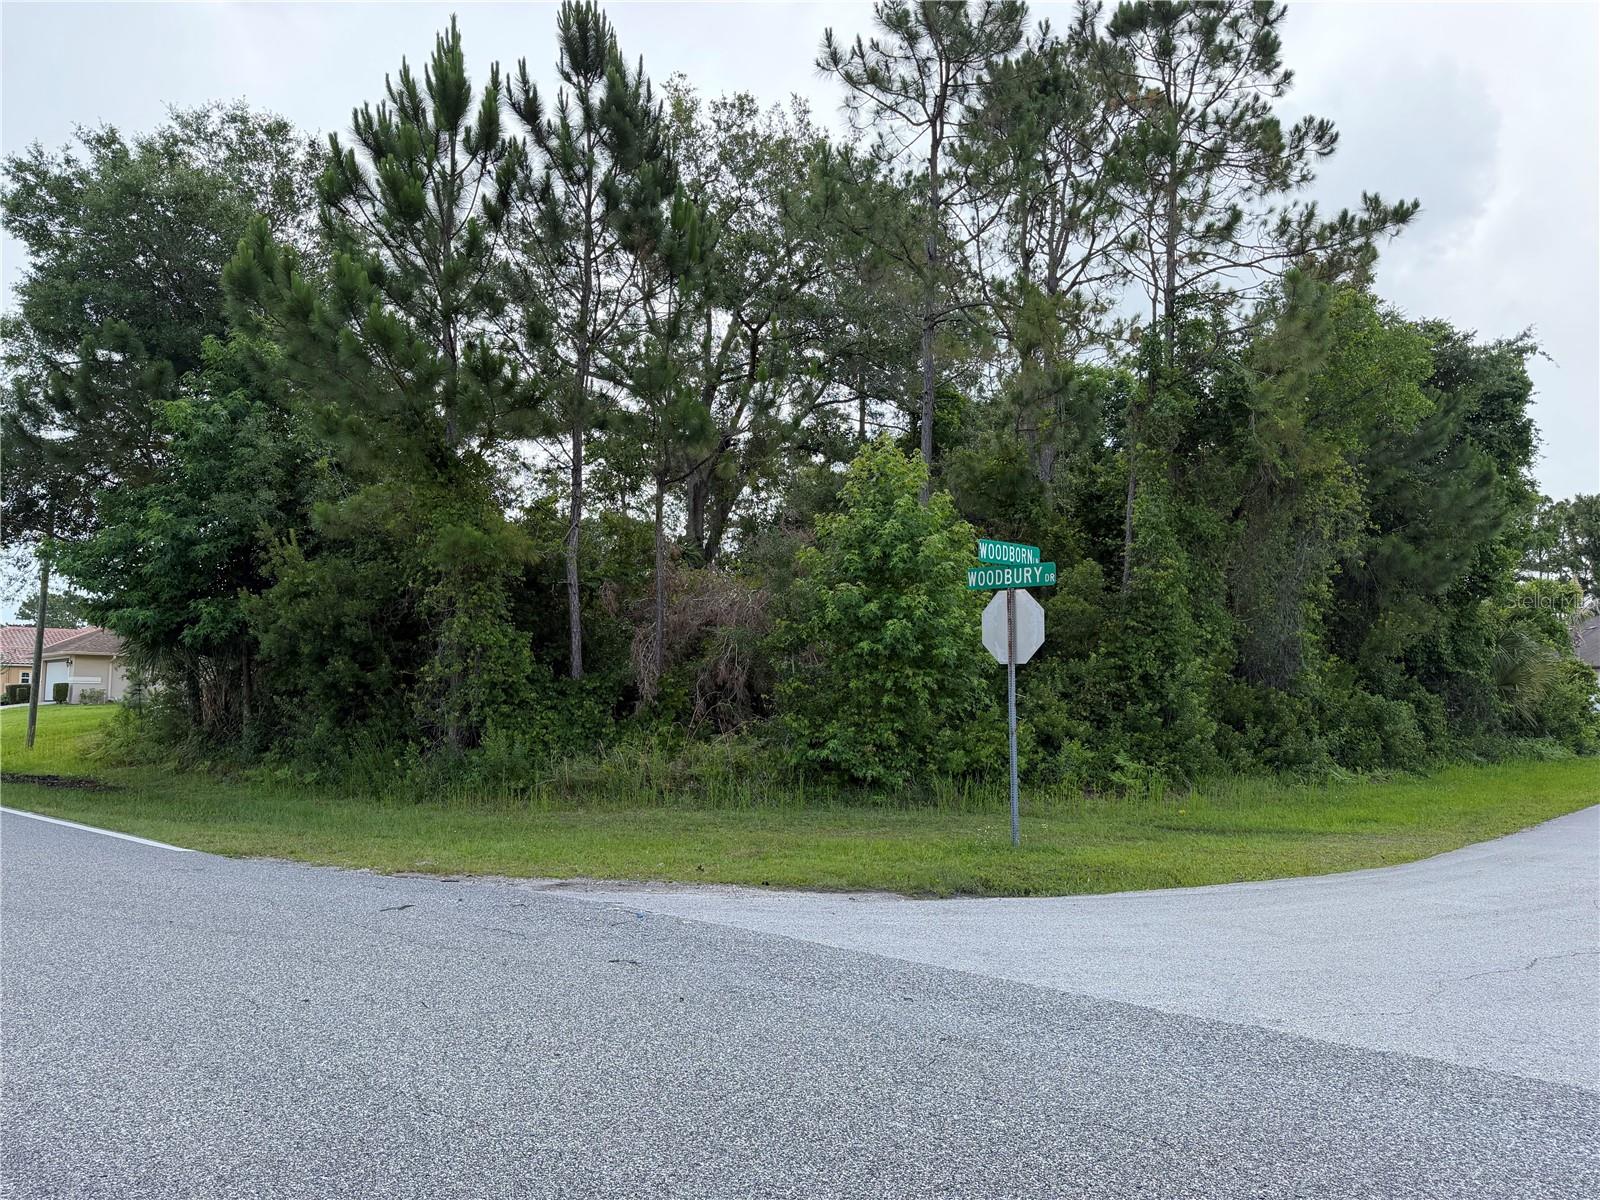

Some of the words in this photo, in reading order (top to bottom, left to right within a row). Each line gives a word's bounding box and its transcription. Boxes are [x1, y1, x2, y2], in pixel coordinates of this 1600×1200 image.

[979, 542, 1033, 564] WOODBORN
[968, 566, 1042, 587] WOODBURY
[1044, 573, 1056, 582] DR
